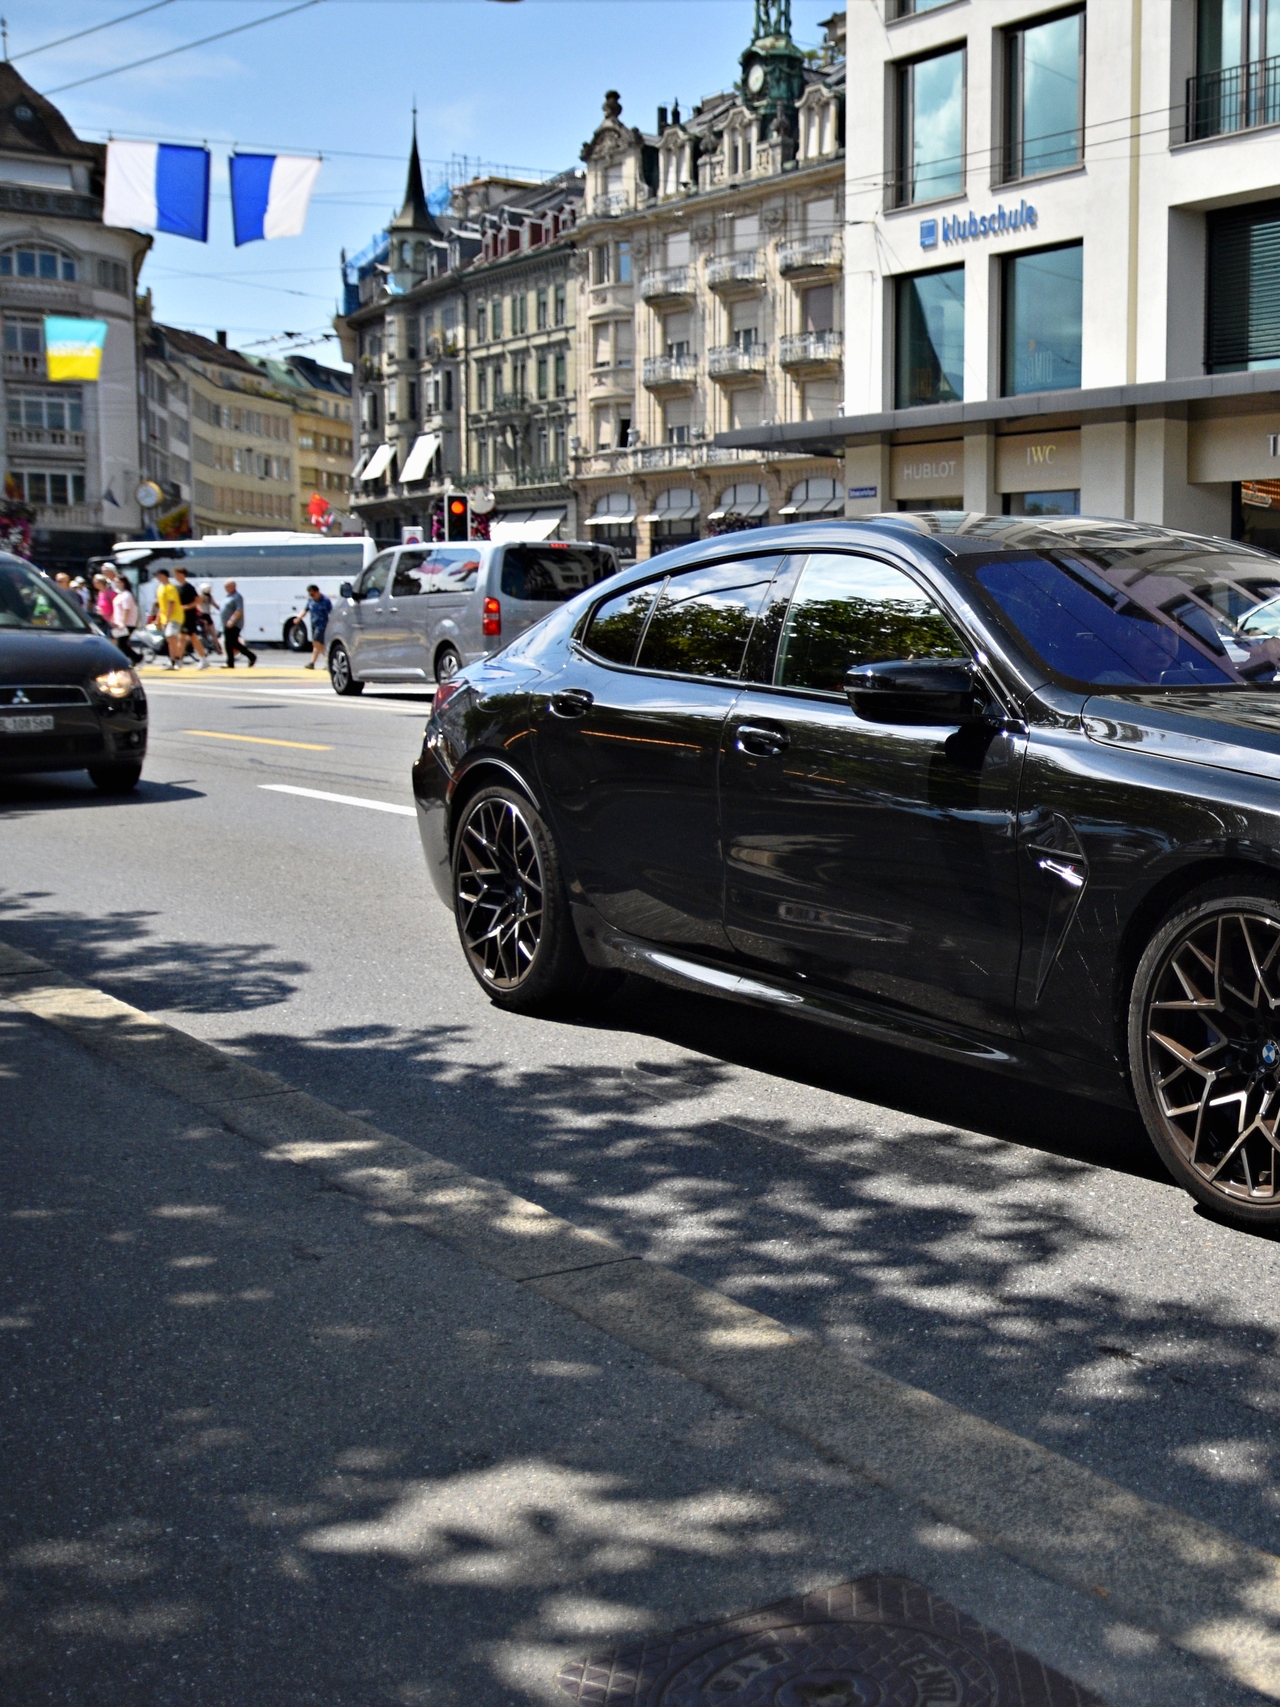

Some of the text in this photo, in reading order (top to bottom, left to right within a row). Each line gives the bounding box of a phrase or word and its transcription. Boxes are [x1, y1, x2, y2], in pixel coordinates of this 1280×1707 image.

[942, 199, 1036, 243] klubschule
[1027, 445, 1056, 465] IWC
[904, 461, 957, 480] HUBLOT
